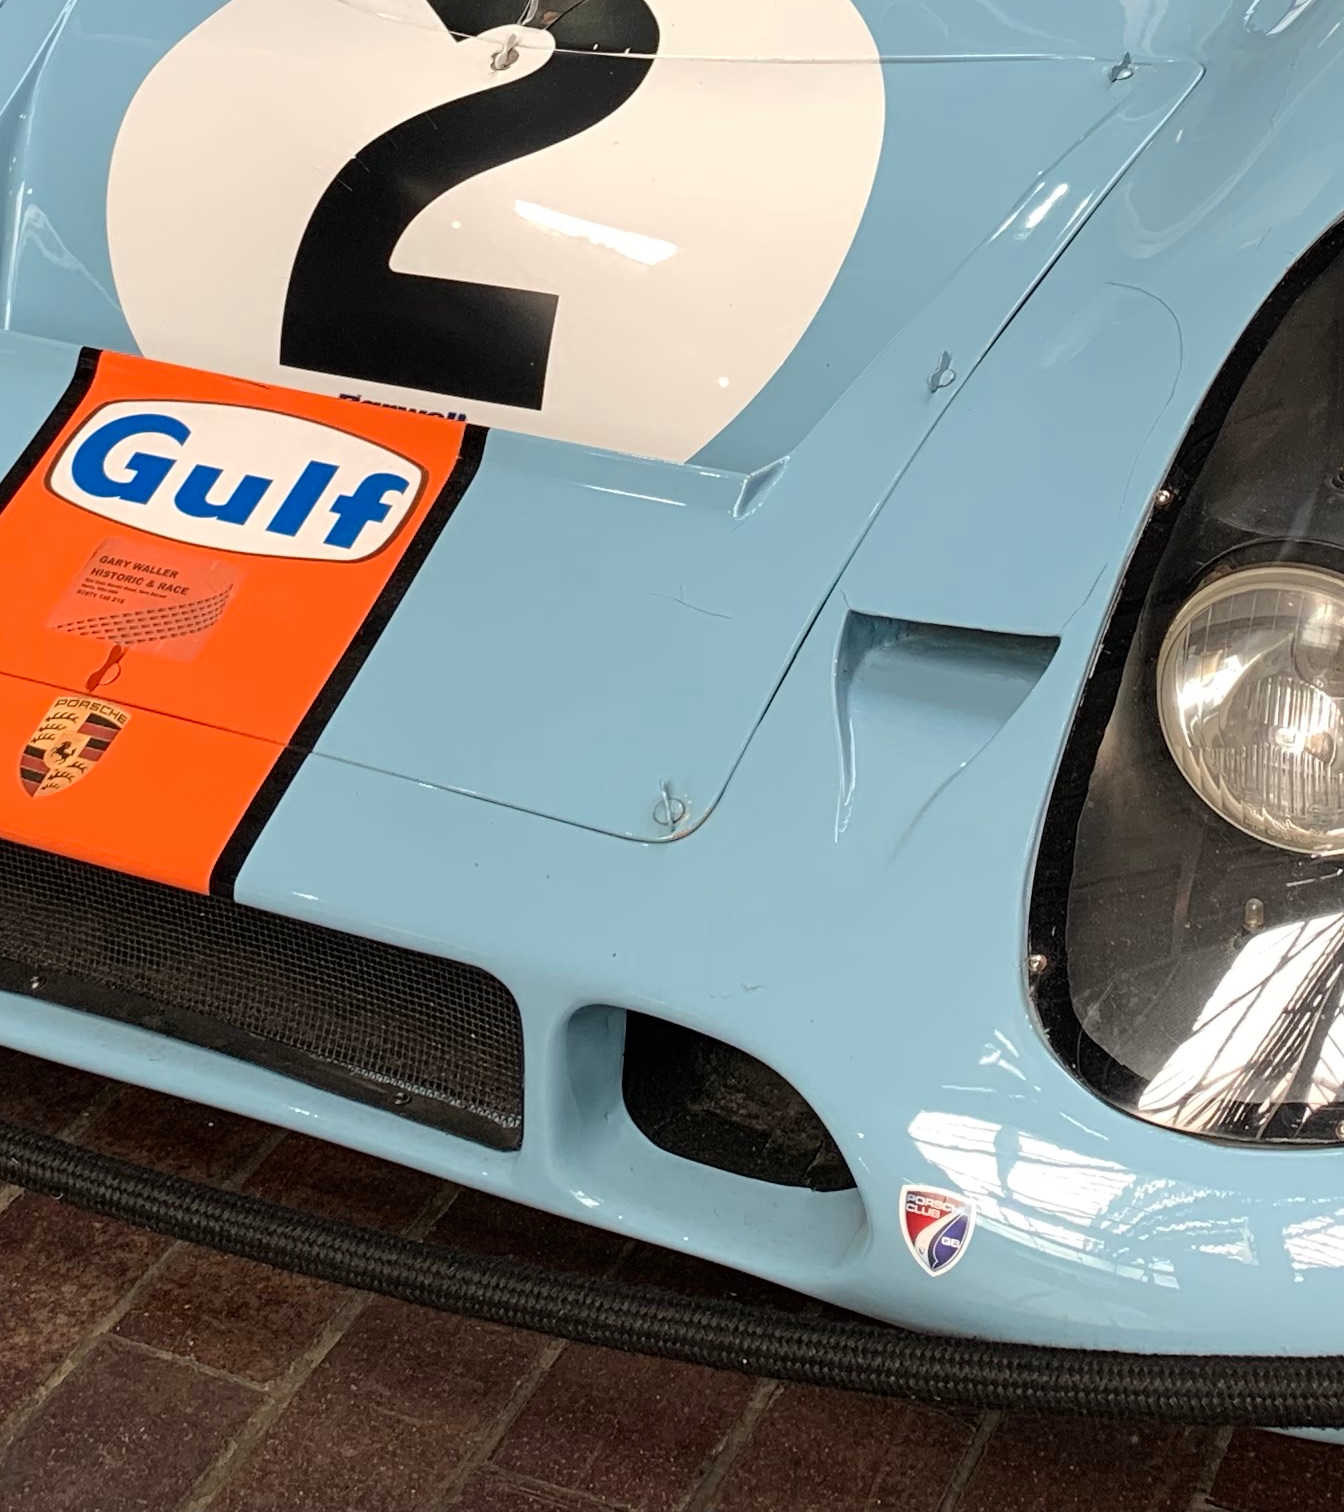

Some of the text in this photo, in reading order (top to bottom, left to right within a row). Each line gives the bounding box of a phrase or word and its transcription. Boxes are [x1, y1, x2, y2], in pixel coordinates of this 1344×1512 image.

[71, 413, 410, 550] Gulf
[99, 555, 179, 579] GARY WALLER
[90, 568, 144, 587] HISTORIC
[157, 581, 189, 596] RACE
[54, 697, 129, 724] PORSCHE
[905, 1193, 956, 1213] PORSC
[905, 1203, 941, 1219] CLUB
